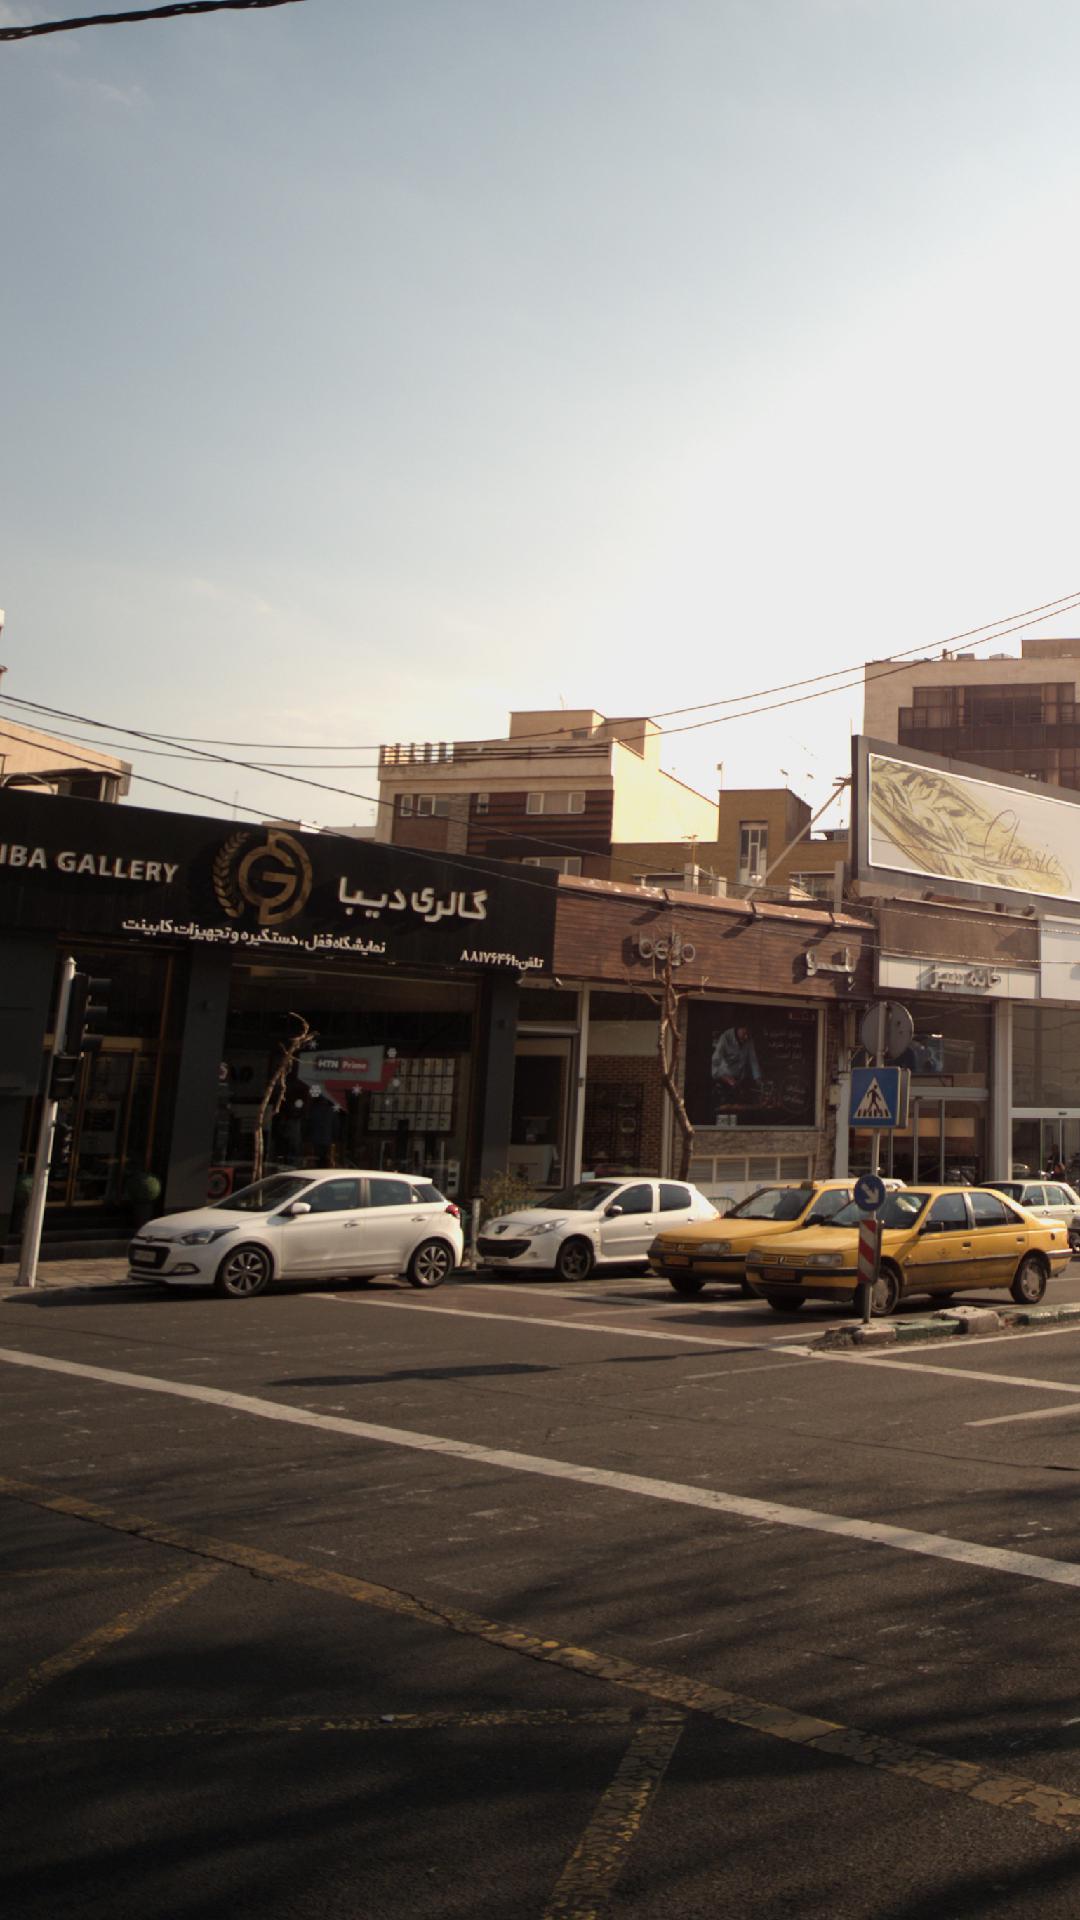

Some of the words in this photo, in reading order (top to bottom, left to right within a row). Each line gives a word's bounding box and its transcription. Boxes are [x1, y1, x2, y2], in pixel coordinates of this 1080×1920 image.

[56, 851, 179, 883] GALLERY
[338, 876, 408, 919] دیبا
[411, 886, 489, 923] گالری
